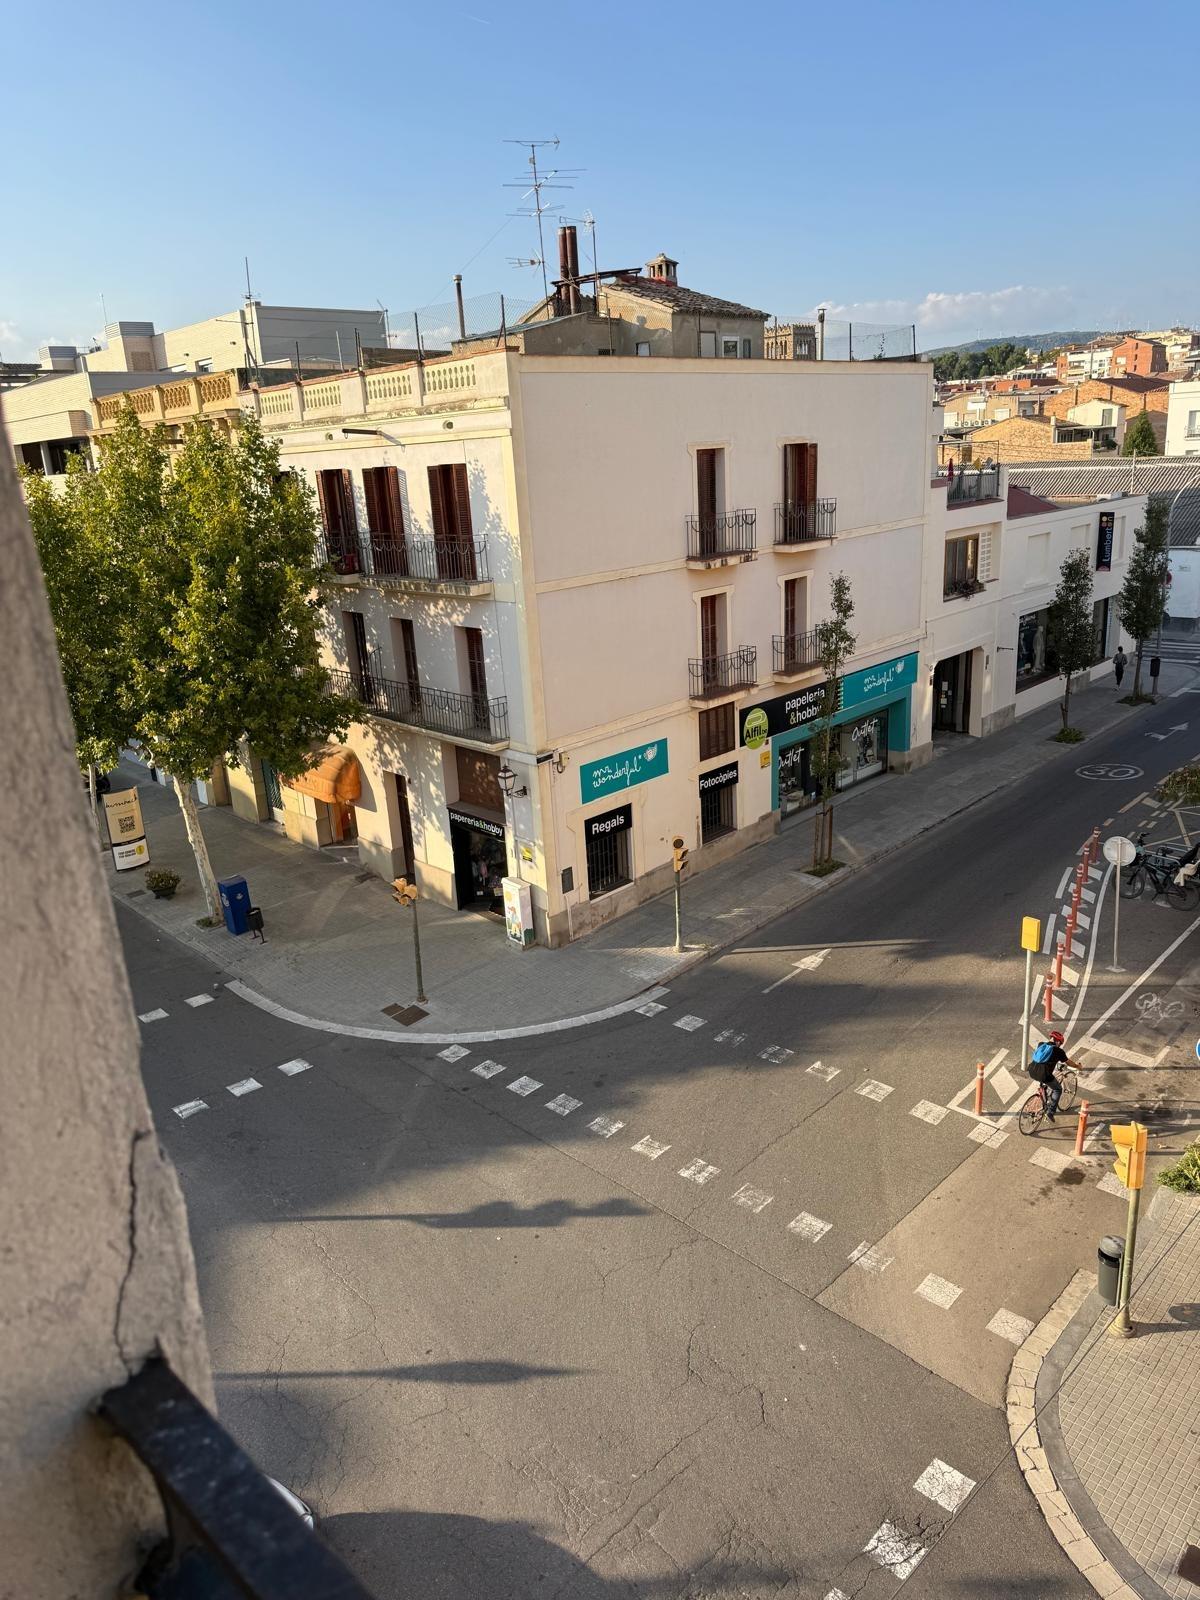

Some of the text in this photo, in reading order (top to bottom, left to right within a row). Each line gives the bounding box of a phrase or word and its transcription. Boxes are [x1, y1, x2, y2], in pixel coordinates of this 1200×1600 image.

[851, 718, 878, 742] Outlet
[699, 768, 737, 790] Fotocòpies
[1083, 766, 1135, 778] 30
[592, 814, 625, 835] Regals
